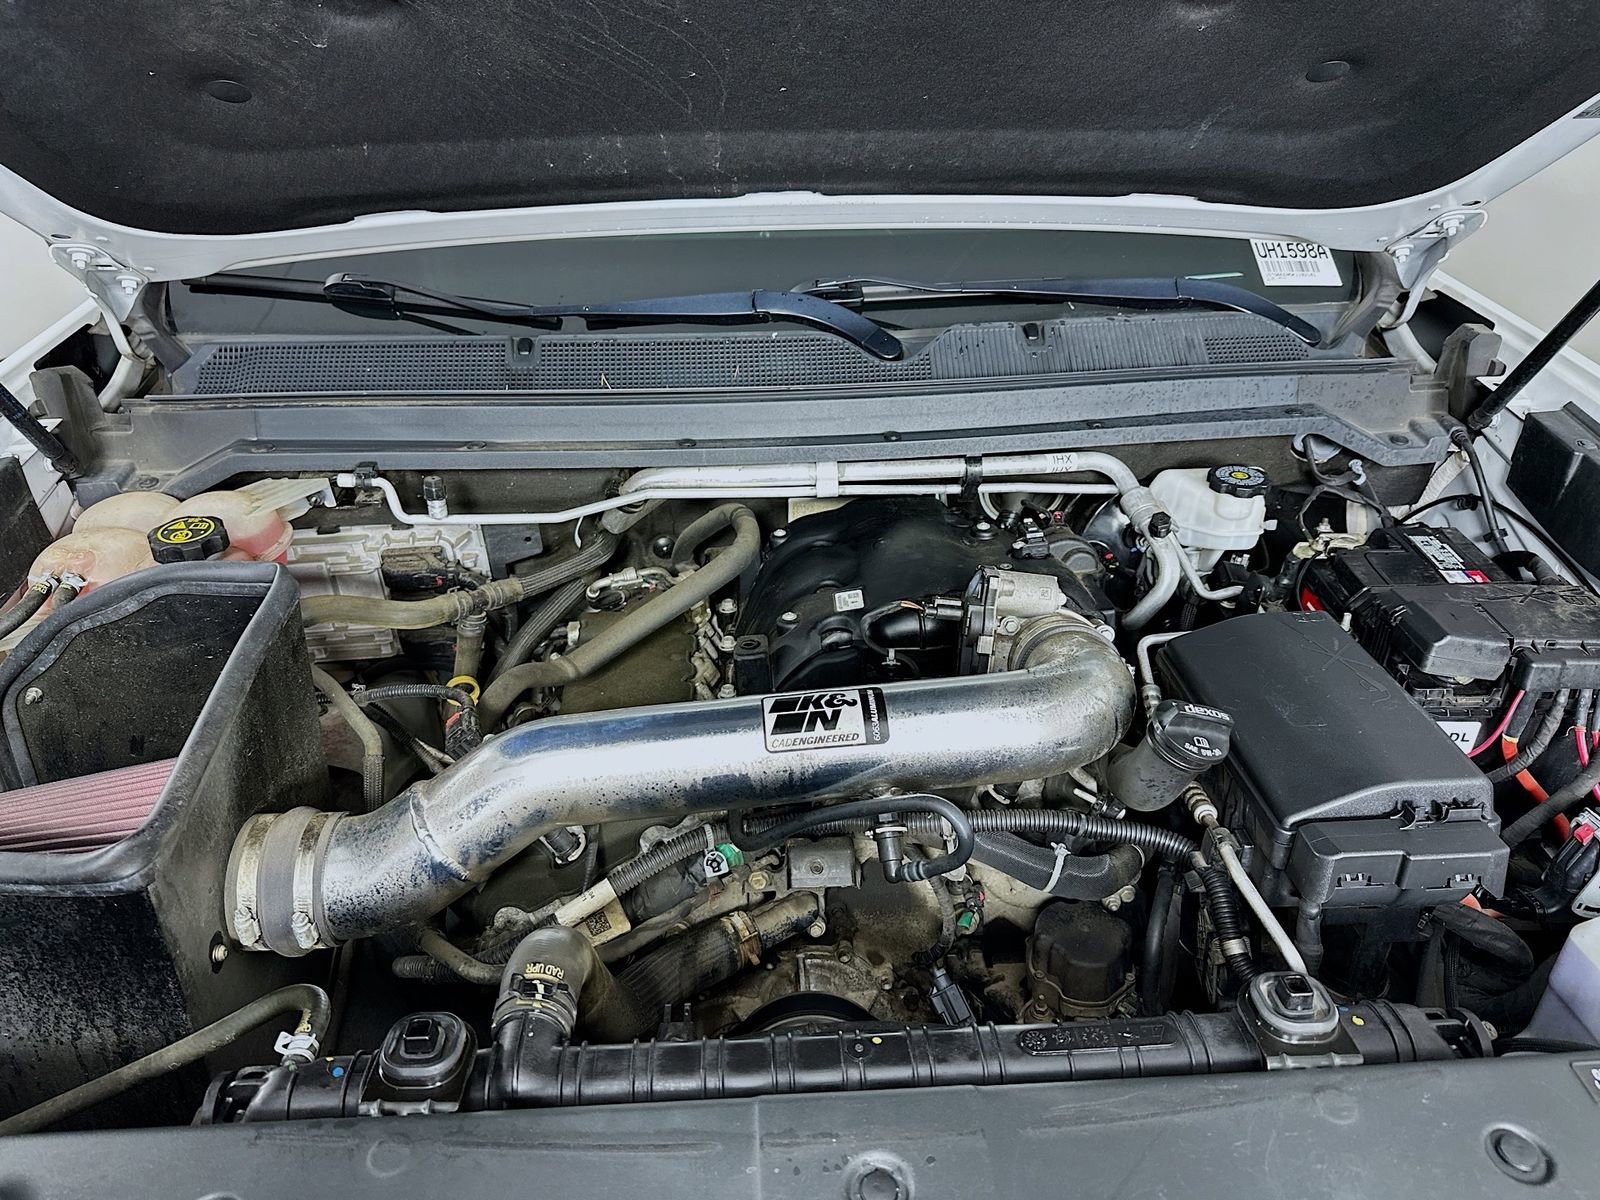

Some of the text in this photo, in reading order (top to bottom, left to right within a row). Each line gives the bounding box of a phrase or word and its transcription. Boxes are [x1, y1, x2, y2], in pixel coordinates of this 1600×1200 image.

[1254, 242, 1329, 259] UH1598A
[1184, 704, 1230, 721] dexos
[525, 963, 565, 979] RAD UPR
